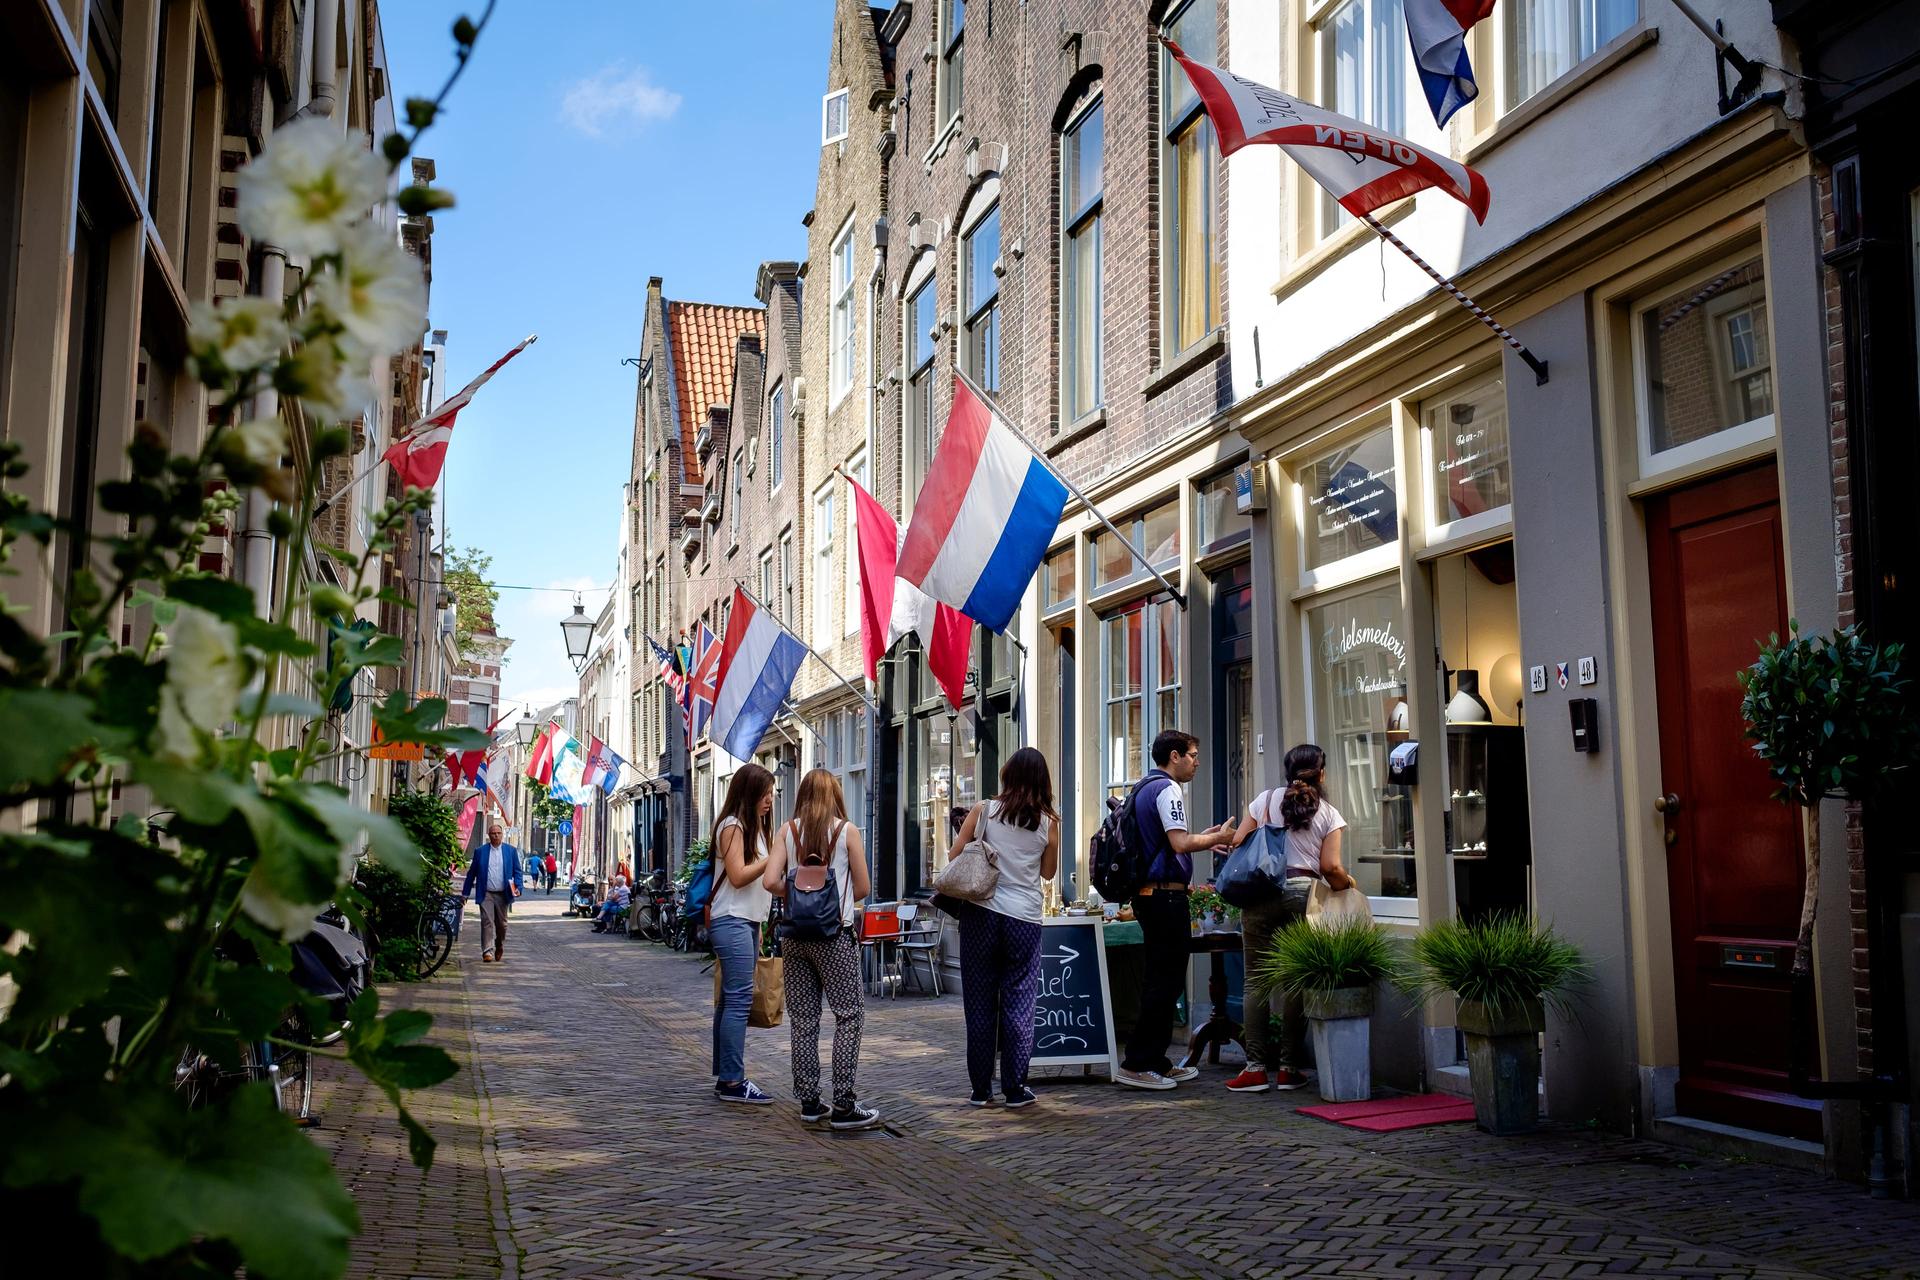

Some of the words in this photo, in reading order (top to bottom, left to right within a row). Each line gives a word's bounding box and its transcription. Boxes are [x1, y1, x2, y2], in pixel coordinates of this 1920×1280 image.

[1581, 660, 1592, 681] 48
[1533, 669, 1542, 689] 46
[1170, 800, 1183, 811] 18
[1170, 811, 1184, 821] 90
